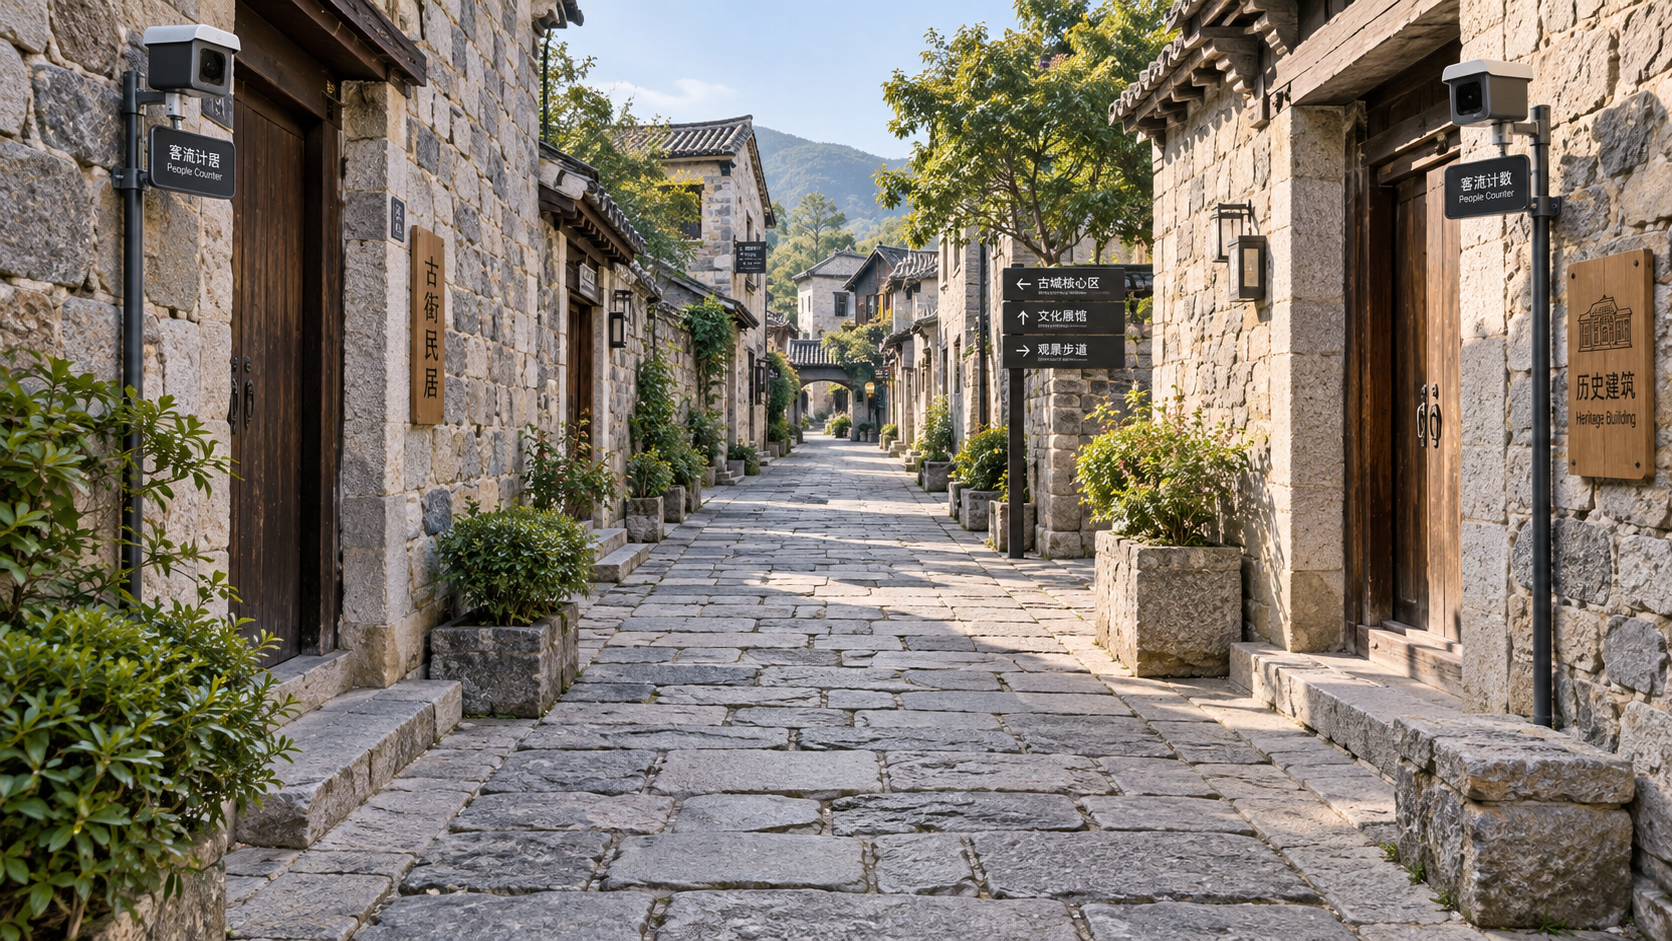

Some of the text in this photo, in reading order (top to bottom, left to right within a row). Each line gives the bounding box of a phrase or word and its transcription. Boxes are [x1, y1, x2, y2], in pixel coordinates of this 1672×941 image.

[167, 162, 223, 181] People Counter
[1458, 190, 1514, 204] People Counter
[424, 256, 439, 399] 古街民居
[1037, 343, 1088, 357] 观景步道
[1576, 371, 1636, 401] 历史建筑
[1576, 409, 1636, 428] Heritage Building
